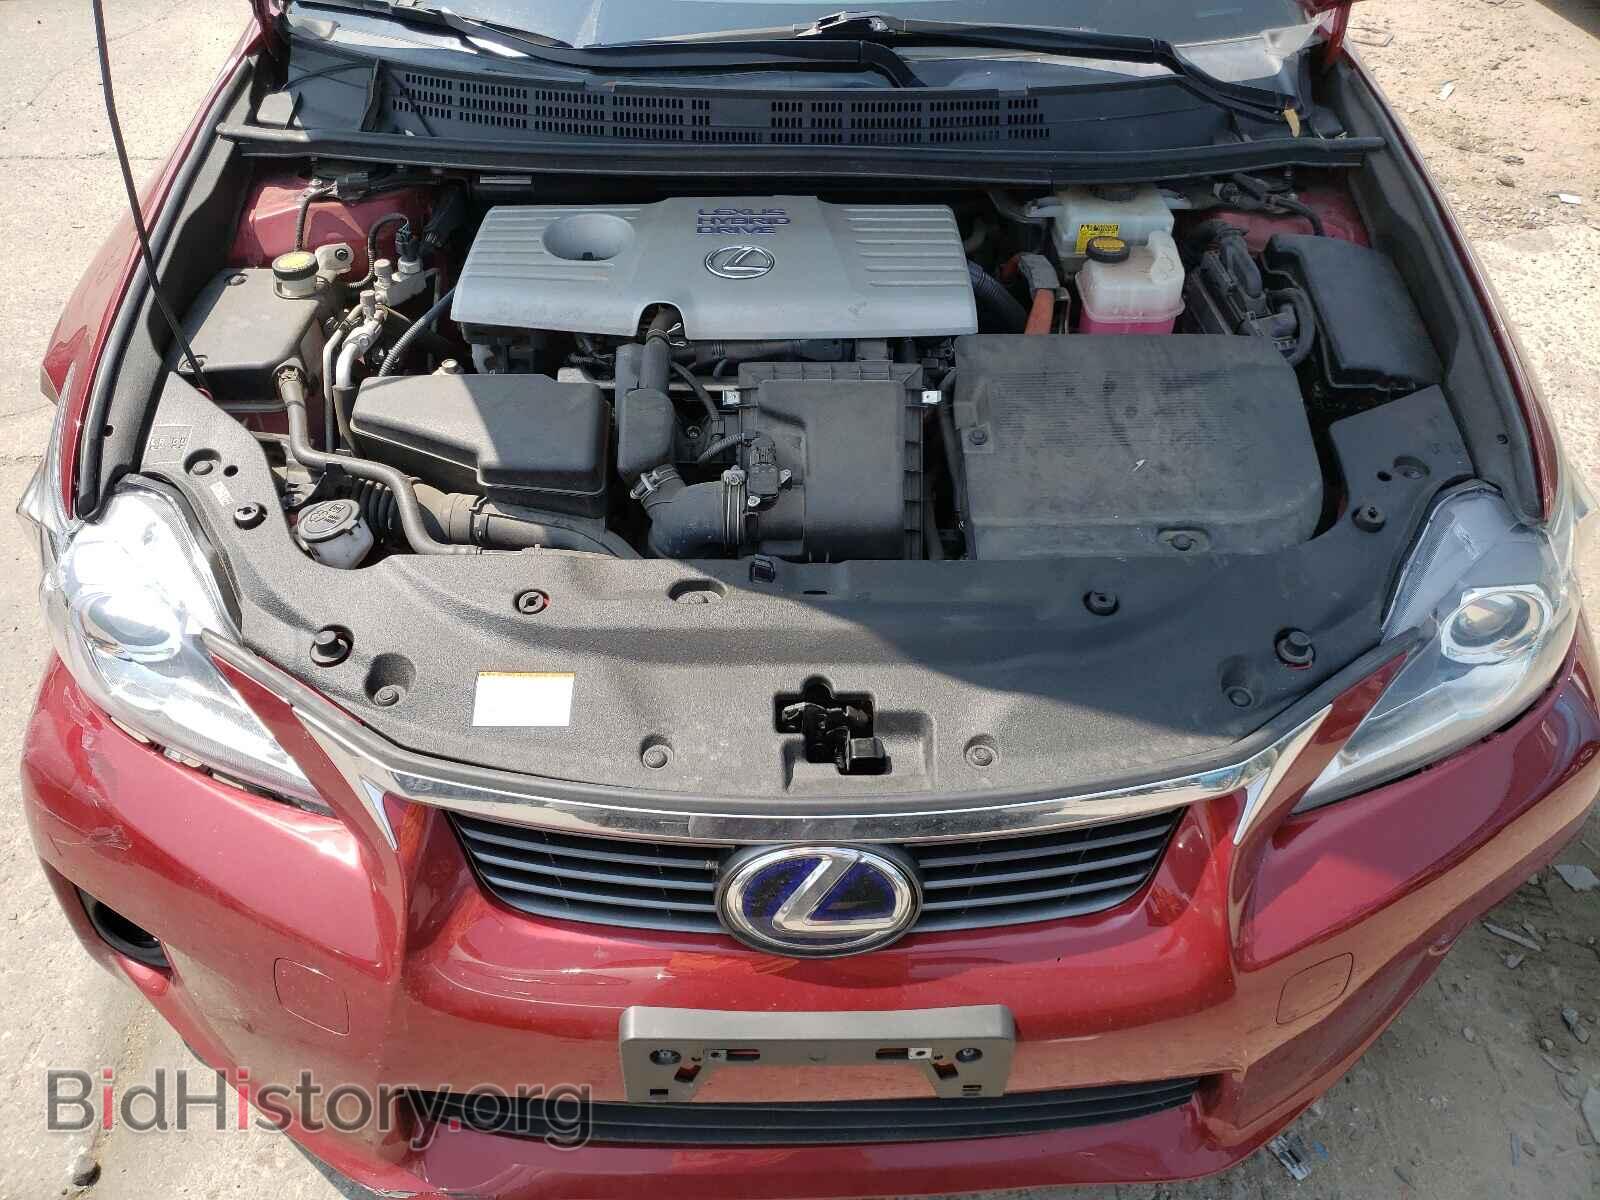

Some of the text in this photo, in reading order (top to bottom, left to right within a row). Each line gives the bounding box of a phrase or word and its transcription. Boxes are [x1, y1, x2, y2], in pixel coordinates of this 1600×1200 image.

[697, 208, 786, 216] LEXUS
[696, 217, 792, 225] HYBRID
[696, 226, 776, 235] DRIVE
